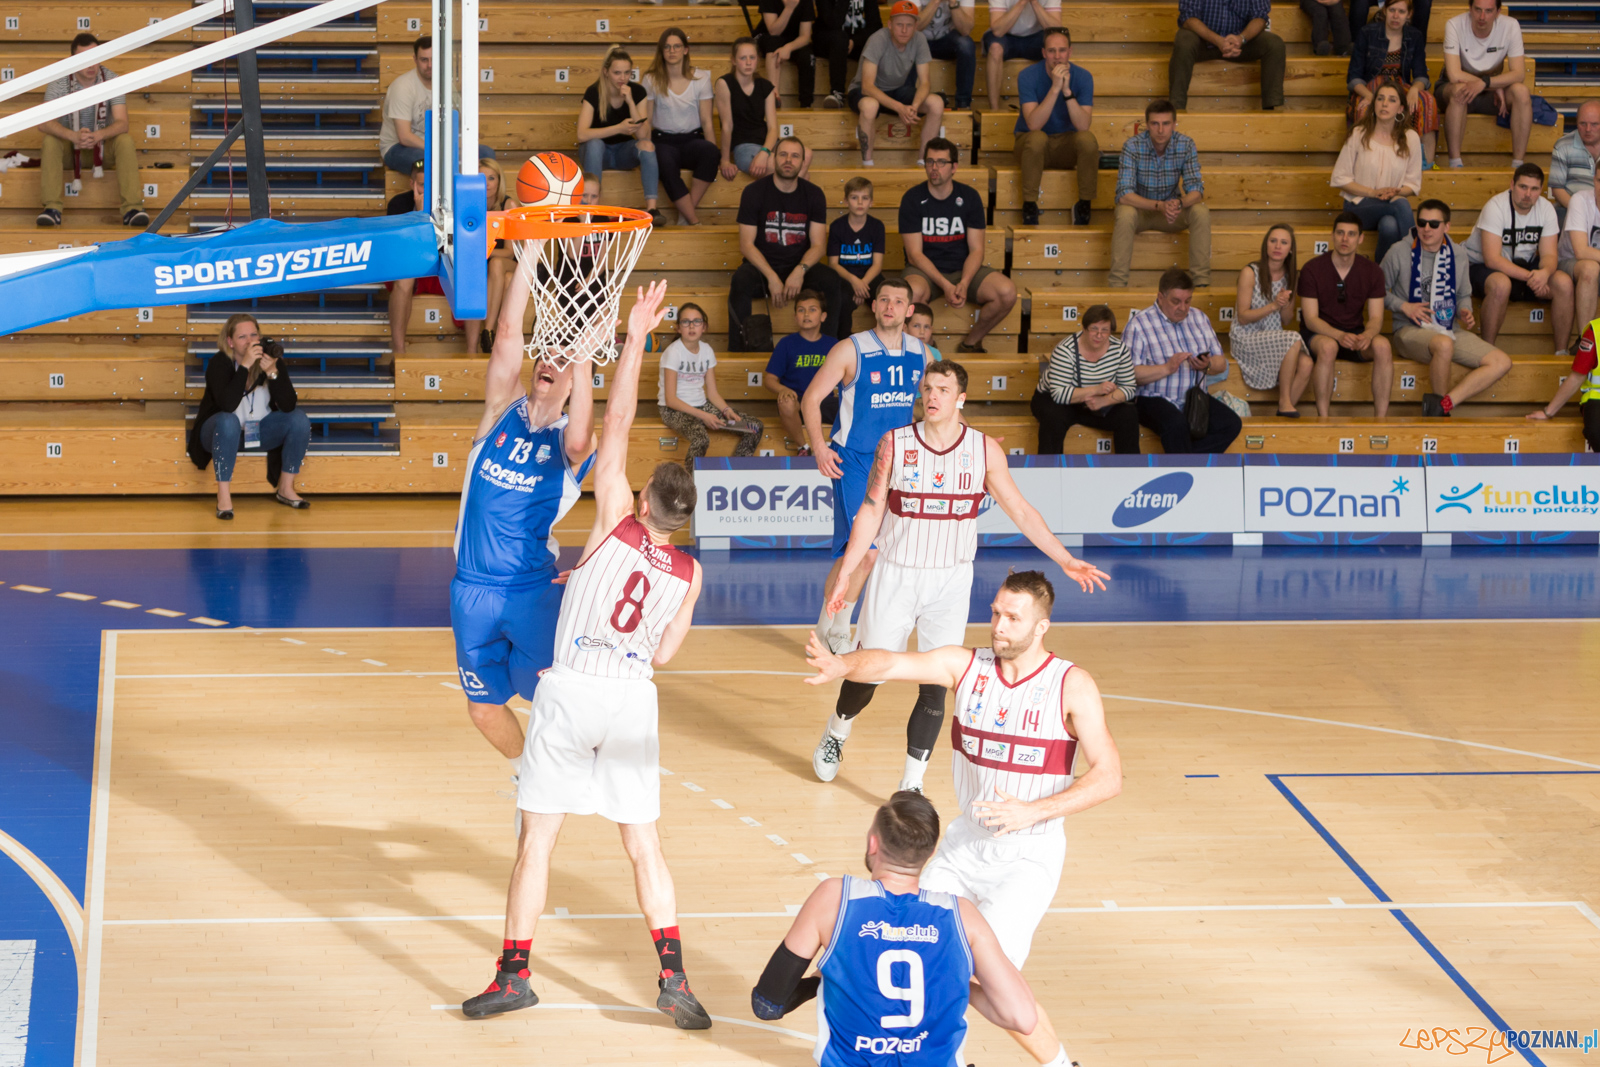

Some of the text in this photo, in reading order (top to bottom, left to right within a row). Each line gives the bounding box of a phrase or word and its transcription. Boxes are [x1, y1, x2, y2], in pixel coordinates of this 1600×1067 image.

[9, 19, 17, 27] 11
[79, 19, 90, 28] 10
[411, 20, 416, 29] 8
[480, 20, 484, 28] 7
[600, 21, 605, 30] 5
[4, 71, 14, 79] 11
[485, 71, 489, 79] 7
[560, 71, 565, 80] 6
[630, 71, 636, 81] 5
[151, 127, 156, 135] 9
[784, 127, 789, 136] 3
[148, 186, 154, 195] 9
[922, 217, 965, 235] USA
[1047, 246, 1057, 255] 16
[1317, 244, 1327, 252] 12
[155, 240, 372, 286] SPORT SYSTEM
[143, 310, 148, 319] 9
[430, 311, 435, 320] 8
[668, 309, 673, 318] 5
[1065, 308, 1076, 318] 16
[1222, 310, 1232, 318] 14
[1531, 311, 1543, 320] 10
[752, 375, 758, 384] 4
[887, 365, 904, 386] 11
[52, 376, 63, 385] 10
[430, 378, 435, 387] 8
[593, 376, 599, 385] 6
[998, 379, 1001, 387] 1
[1403, 378, 1414, 387] 12
[49, 445, 60, 455] 10
[1099, 440, 1110, 451] 16
[1342, 441, 1352, 450] 13
[1425, 441, 1436, 450] 12
[1508, 442, 1517, 450] 11
[508, 437, 533, 464] 13
[438, 455, 443, 464] 8
[959, 472, 971, 490] 10
[1124, 490, 1178, 508] atrem
[1481, 485, 1600, 505] funclub
[1533, 505, 1599, 515] podróży
[758, 515, 814, 523] PRODUCENT
[610, 571, 650, 633] 8
[459, 666, 485, 689] 13
[1022, 709, 1040, 732] 14
[985, 747, 1005, 757] MPGK
[1018, 753, 1036, 763] ZZO
[882, 924, 938, 937] funclub
[876, 949, 925, 1029] 9
